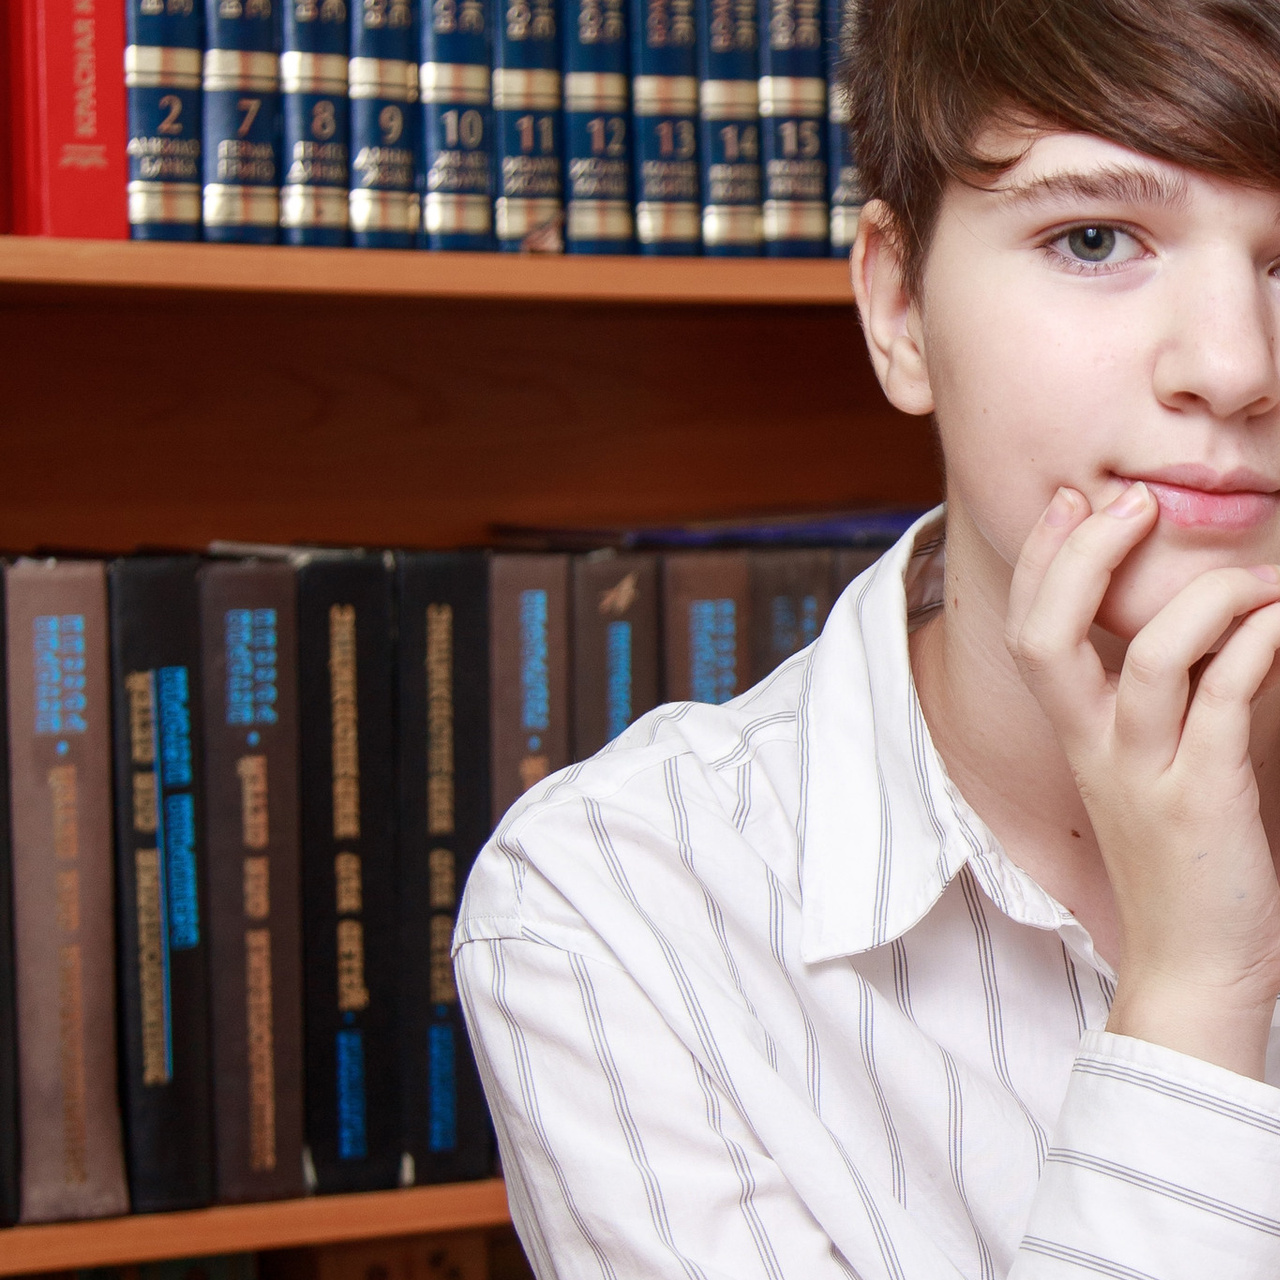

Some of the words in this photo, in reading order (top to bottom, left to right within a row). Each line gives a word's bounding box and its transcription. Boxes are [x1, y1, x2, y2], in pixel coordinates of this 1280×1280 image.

[157, 95, 183, 135] 2
[237, 98, 262, 137] 7
[311, 101, 336, 140] 8
[378, 105, 404, 144] 9
[441, 109, 483, 149] 10
[515, 115, 554, 153] 11
[586, 117, 626, 156] 12
[654, 120, 696, 159] 13
[721, 124, 758, 161] 14
[780, 120, 821, 158] 15
